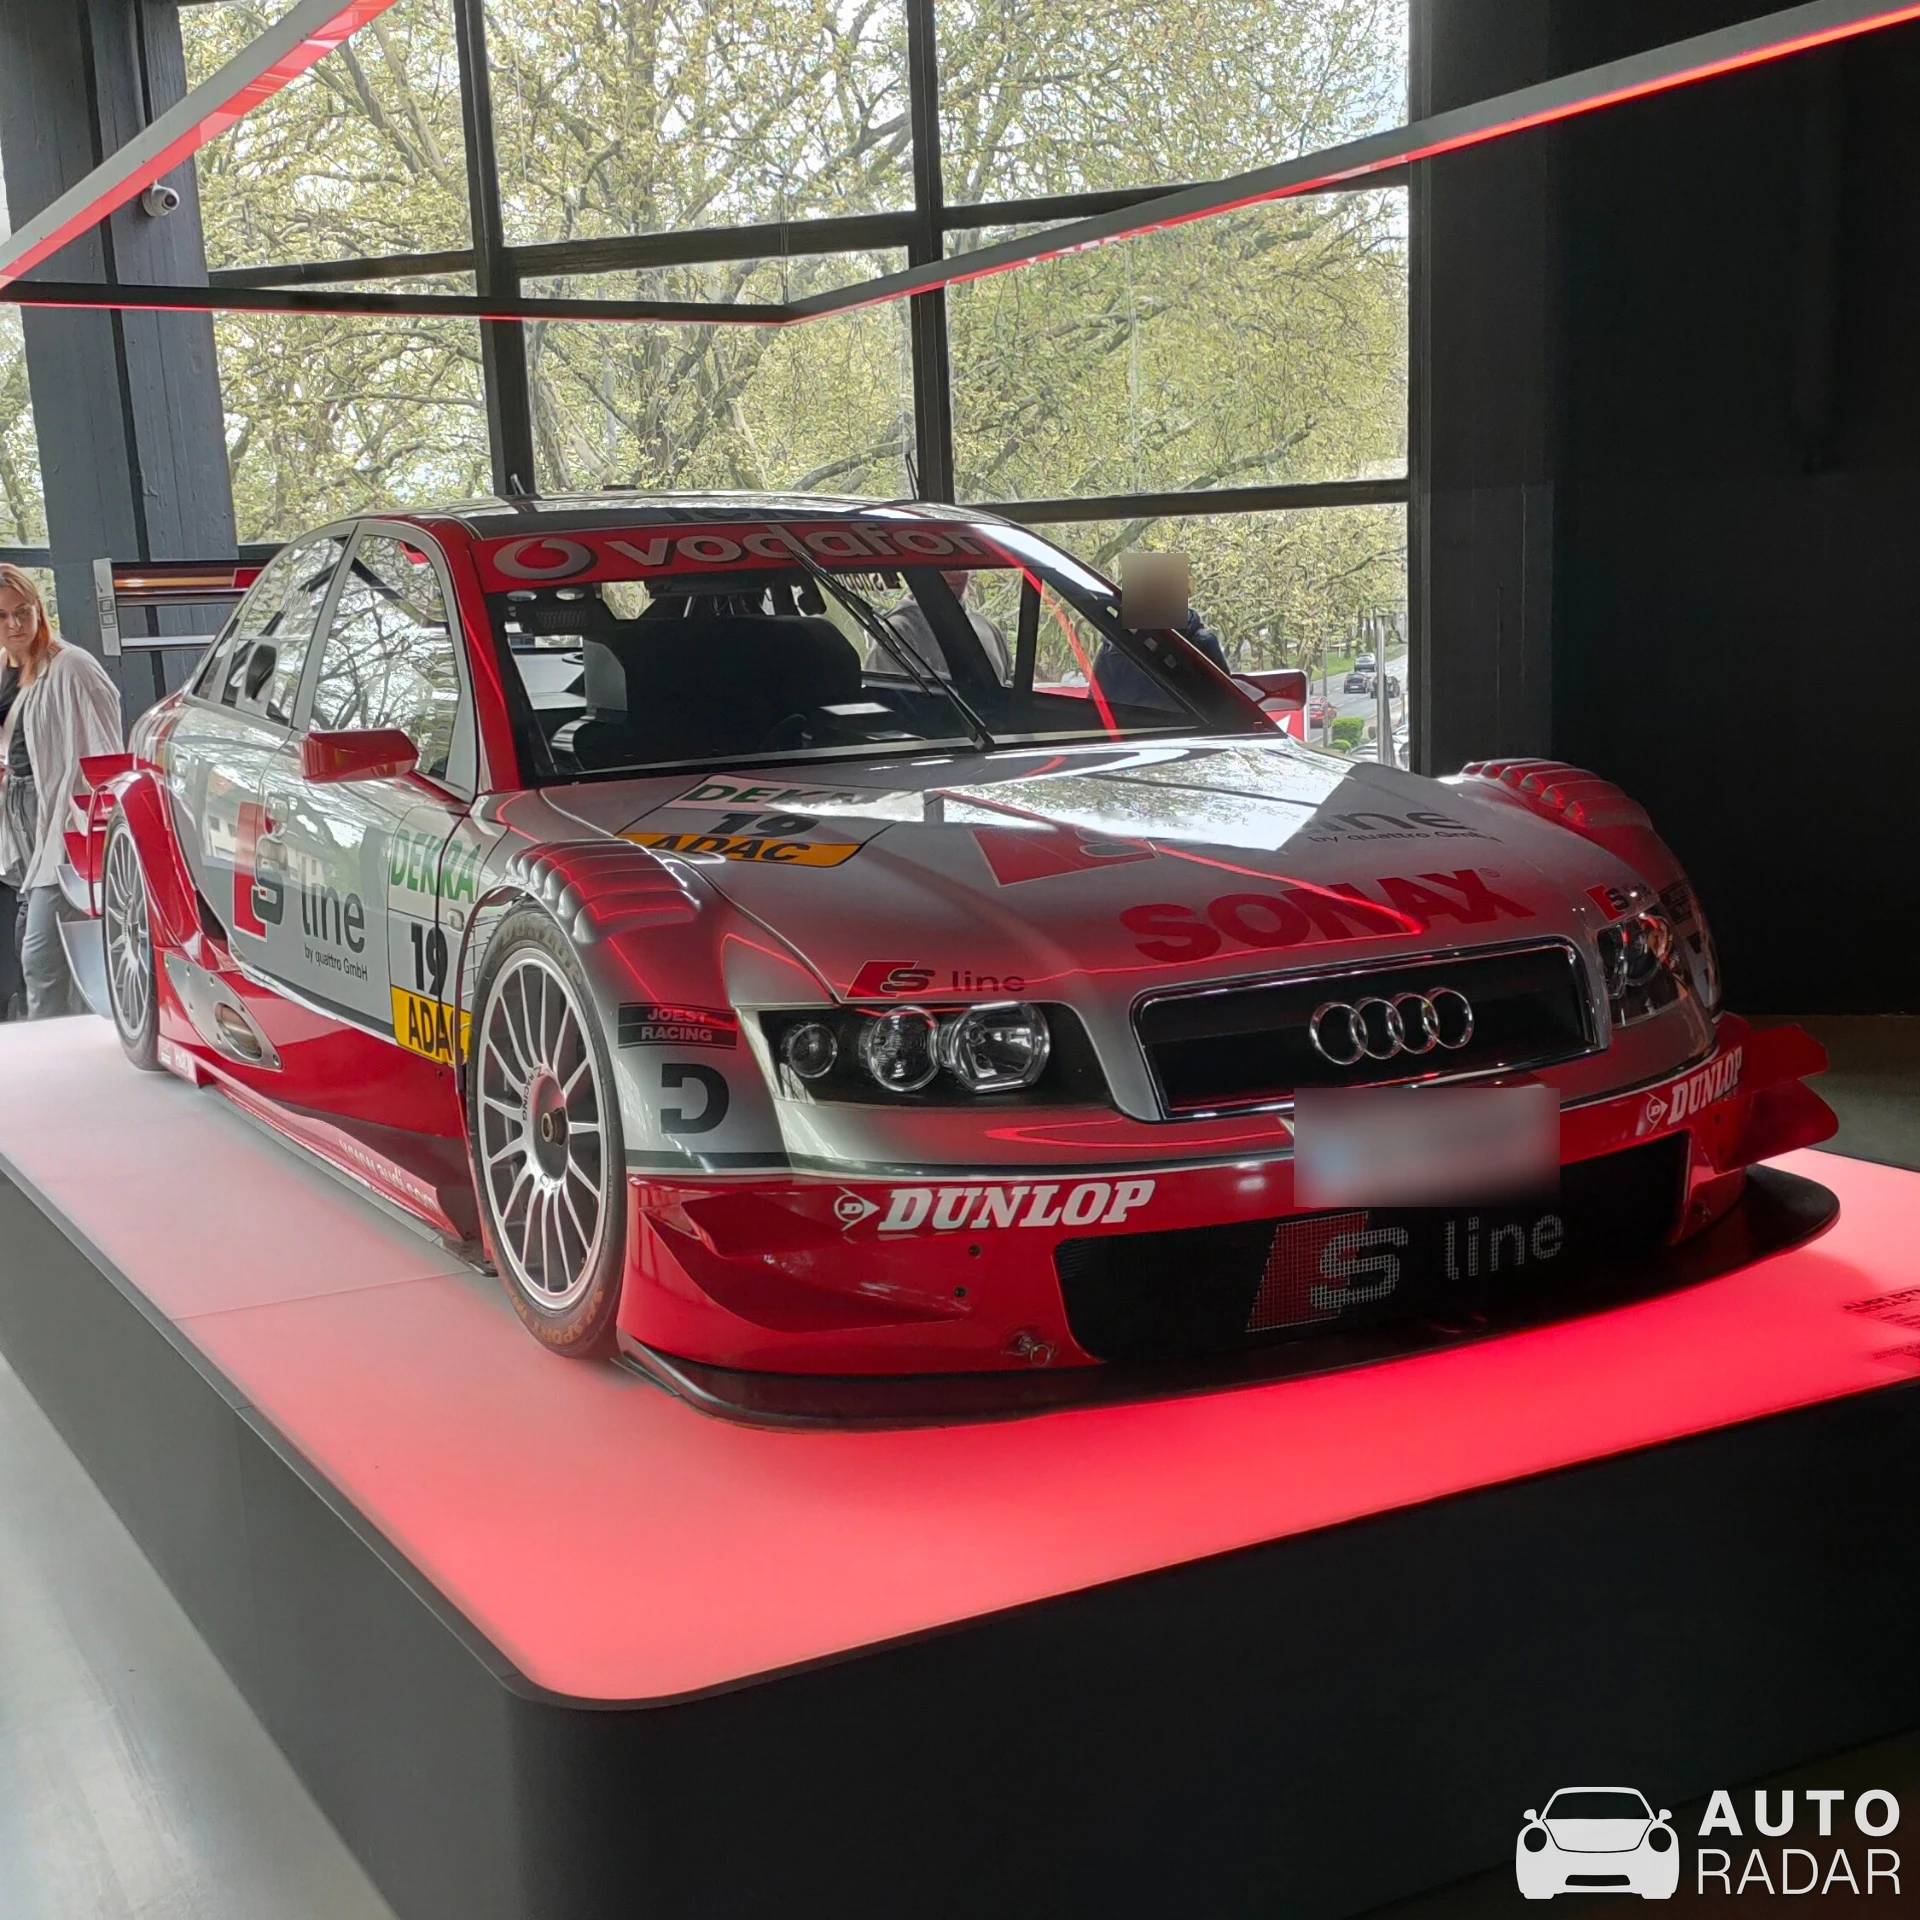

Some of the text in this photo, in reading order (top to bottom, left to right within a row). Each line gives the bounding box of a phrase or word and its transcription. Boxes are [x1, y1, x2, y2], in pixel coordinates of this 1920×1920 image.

[707, 813, 819, 837] 19
[649, 835, 811, 861] ADAC
[391, 829, 481, 903] DEKRA
[343, 957, 368, 982] GmbH
[410, 922, 448, 997] 19
[952, 971, 1026, 993] line
[647, 1008, 709, 1023] JOEST
[641, 1026, 713, 1041] RACING
[1667, 1045, 1742, 1125] DUNLOP
[877, 1180, 1156, 1231] DUNLOP
[1443, 1214, 1563, 1280] line
